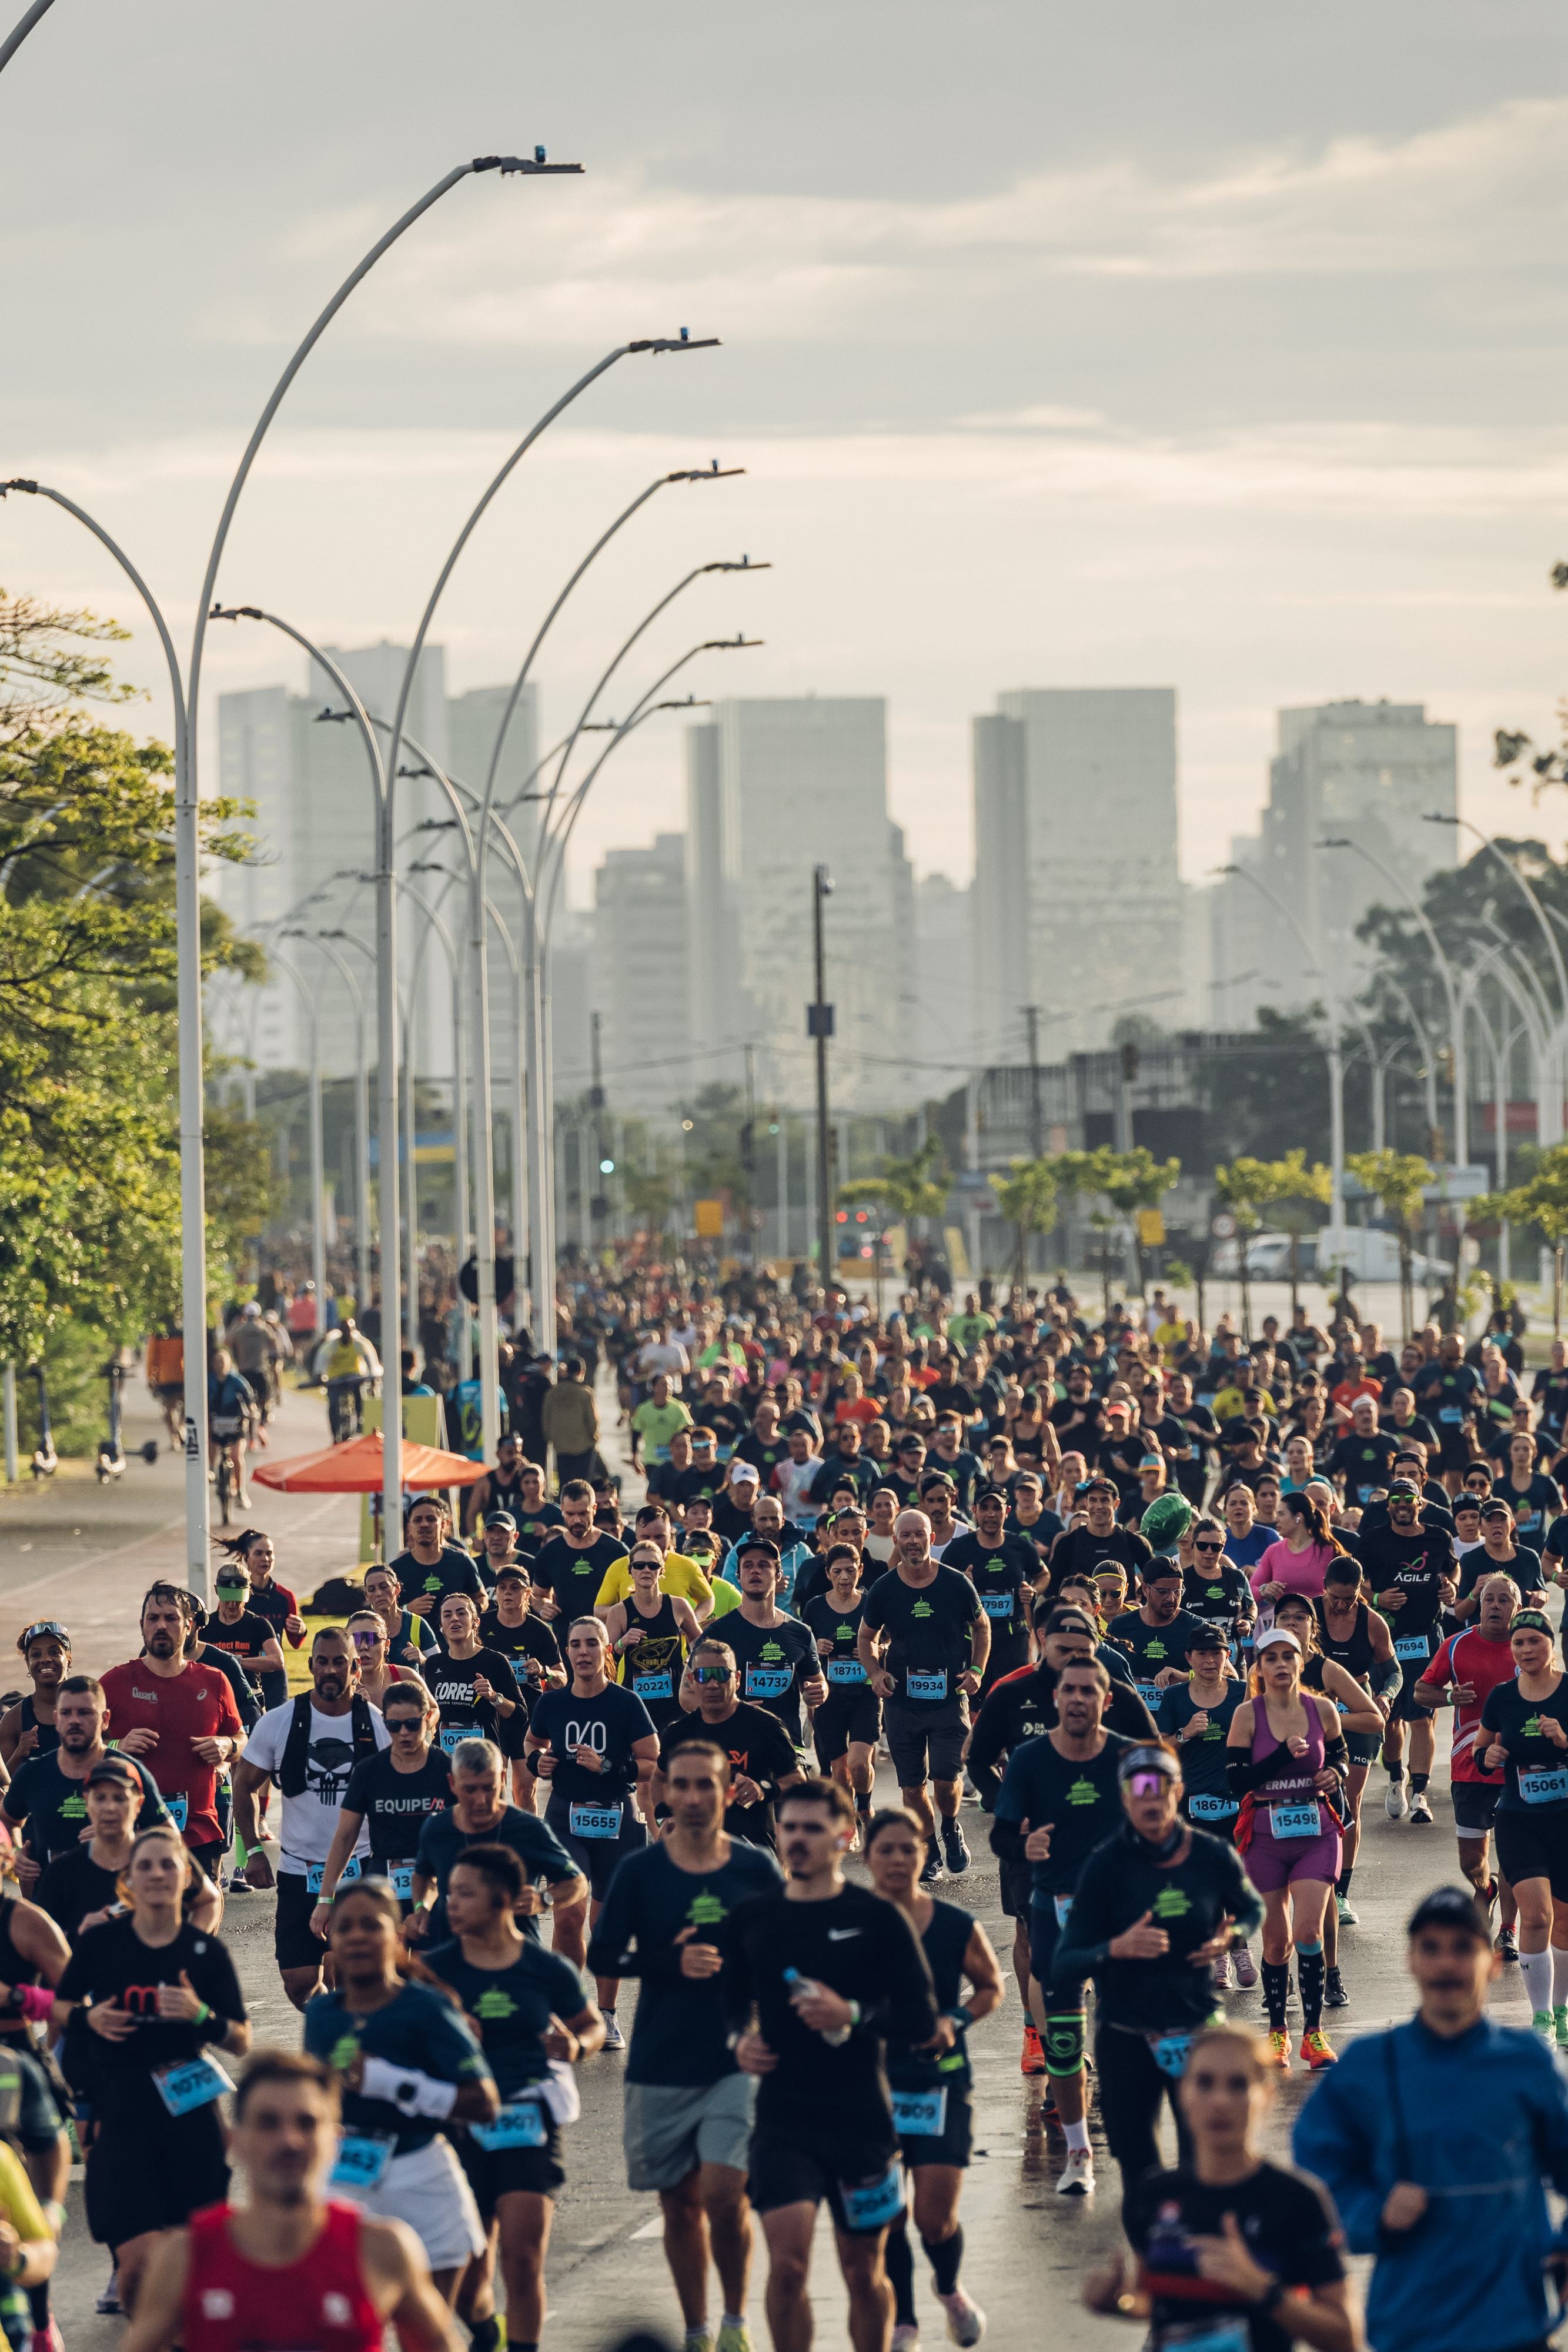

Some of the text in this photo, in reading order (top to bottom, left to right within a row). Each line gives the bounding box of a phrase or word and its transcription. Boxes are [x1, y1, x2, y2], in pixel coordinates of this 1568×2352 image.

[235, 1641, 250, 1650] Run
[833, 1666, 861, 1675] 18711
[637, 1681, 669, 1692] 20221
[752, 1676, 788, 1688] 14732
[910, 1681, 943, 1691] 19934
[132, 1686, 158, 1701] Quark
[435, 1682, 474, 1701] CORRE
[1525, 1778, 1566, 1793] 15061
[1195, 1800, 1232, 1812] 18671
[575, 1815, 617, 1829] 15655
[1276, 1813, 1318, 1828] 15498
